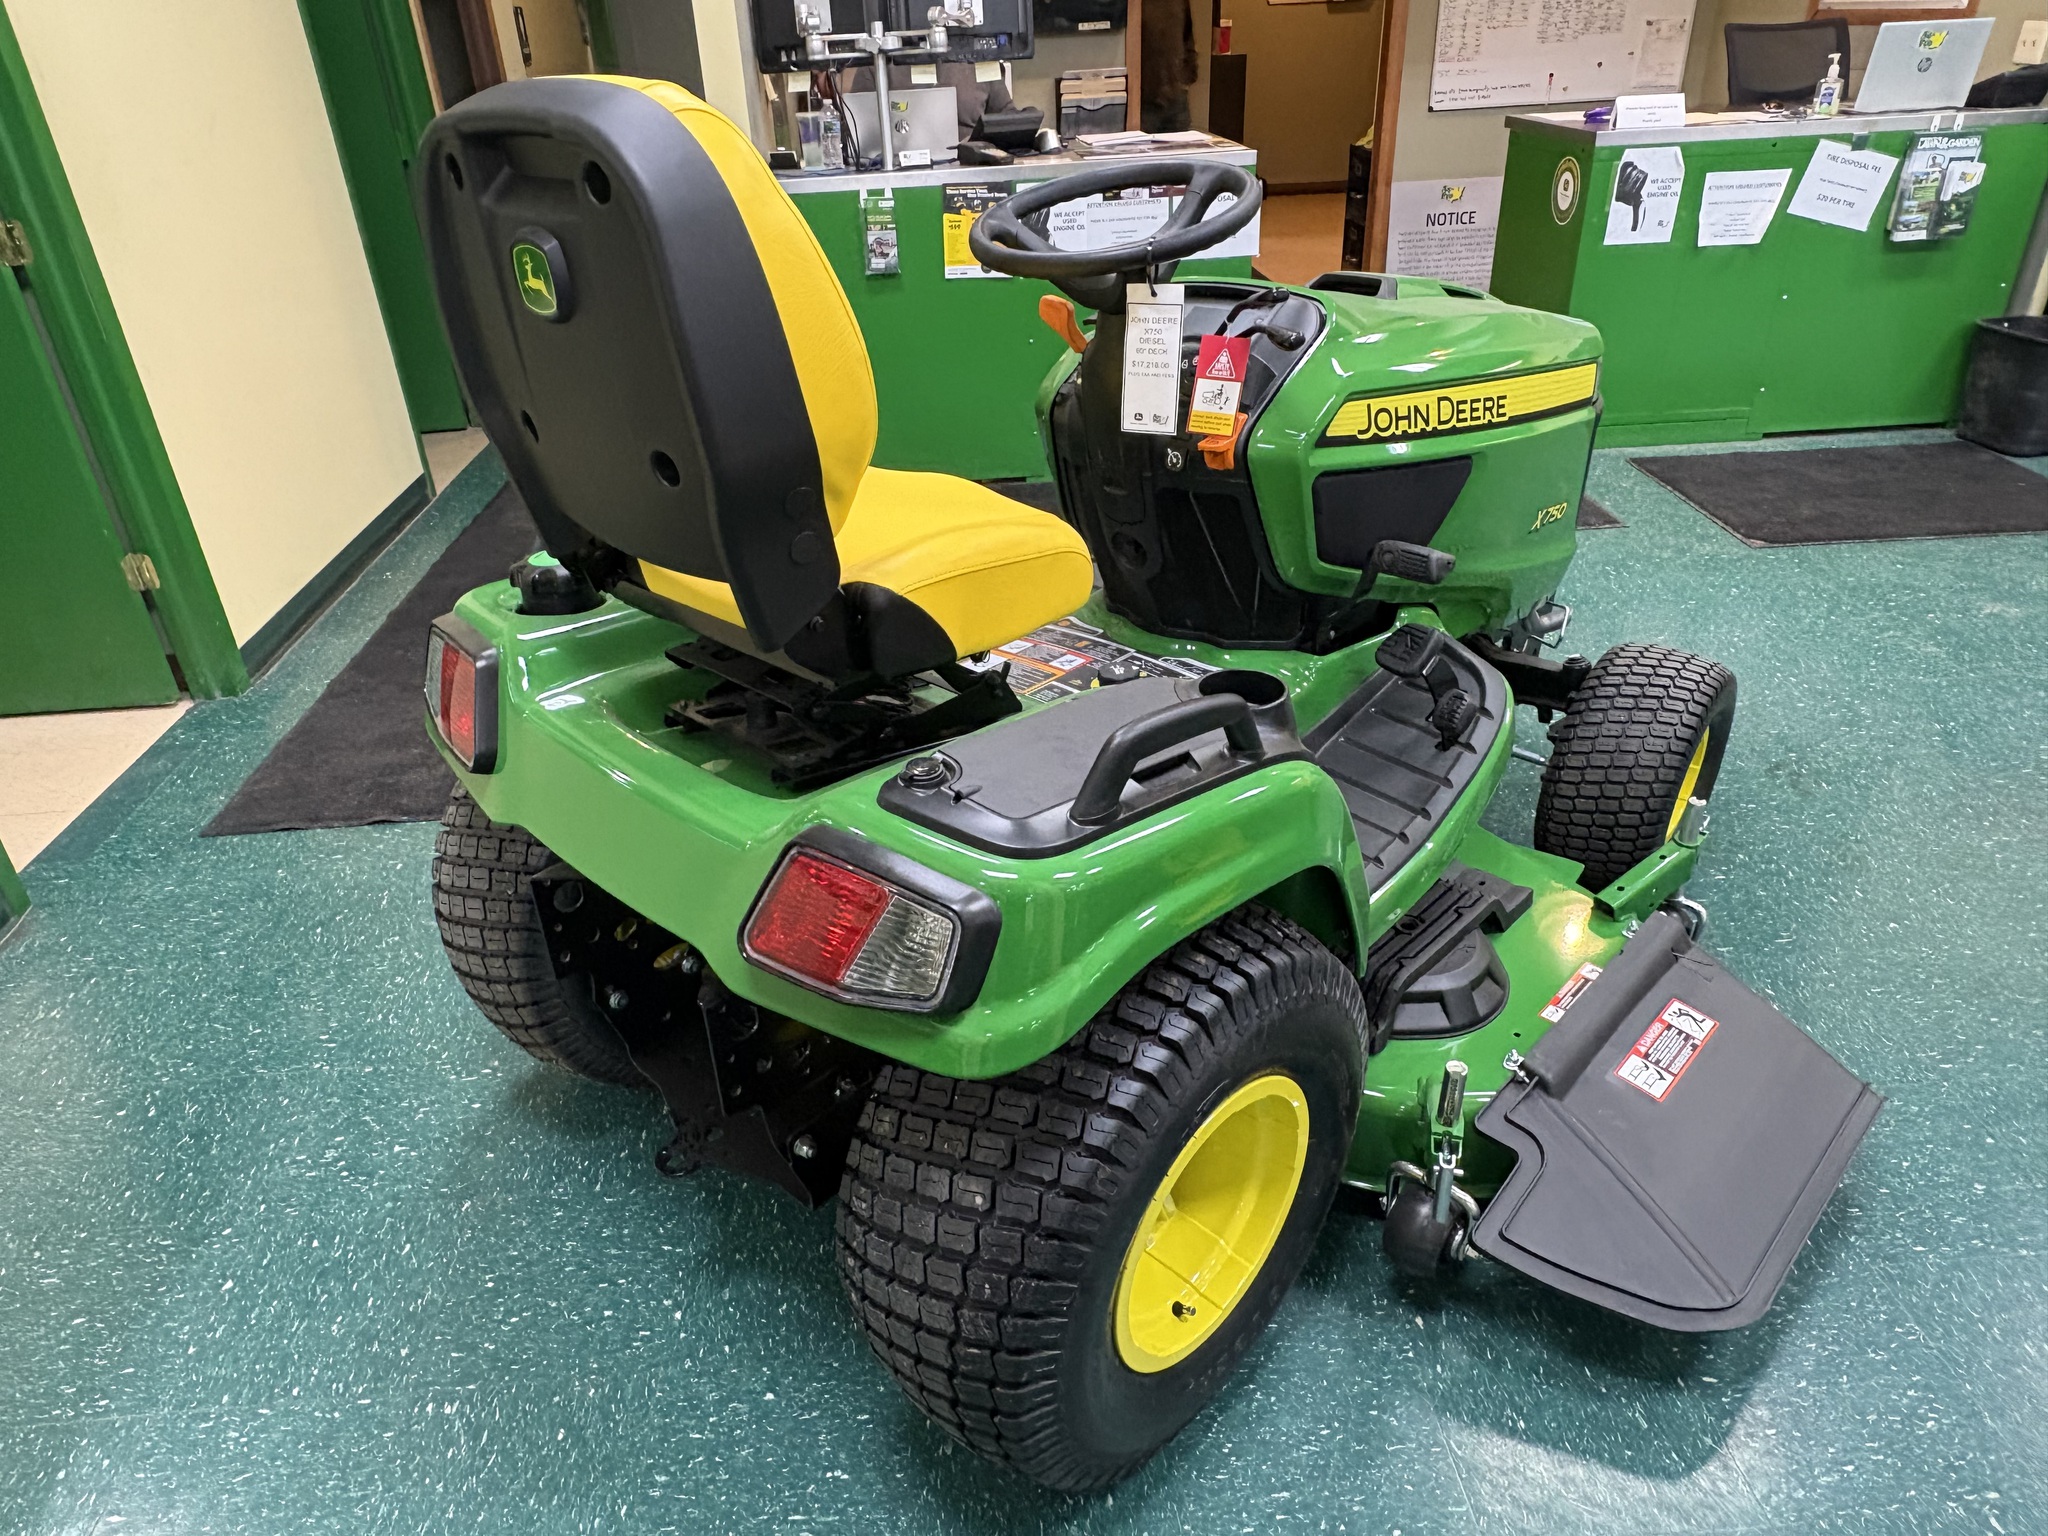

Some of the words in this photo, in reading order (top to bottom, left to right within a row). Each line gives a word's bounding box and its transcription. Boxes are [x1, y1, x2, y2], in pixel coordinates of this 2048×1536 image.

[1840, 157, 1870, 171] DISPOSAL
[1426, 211, 1477, 227] NOTICE
[1130, 316, 1150, 324] JOHN
[1152, 316, 1178, 325] DEERE
[1144, 328, 1163, 336] X750
[1139, 336, 1166, 345] DIESEL
[1147, 347, 1168, 355] DECK
[1357, 403, 1431, 436] JOHN
[1436, 394, 1509, 426] DEERE
[1529, 501, 1568, 532] X750
